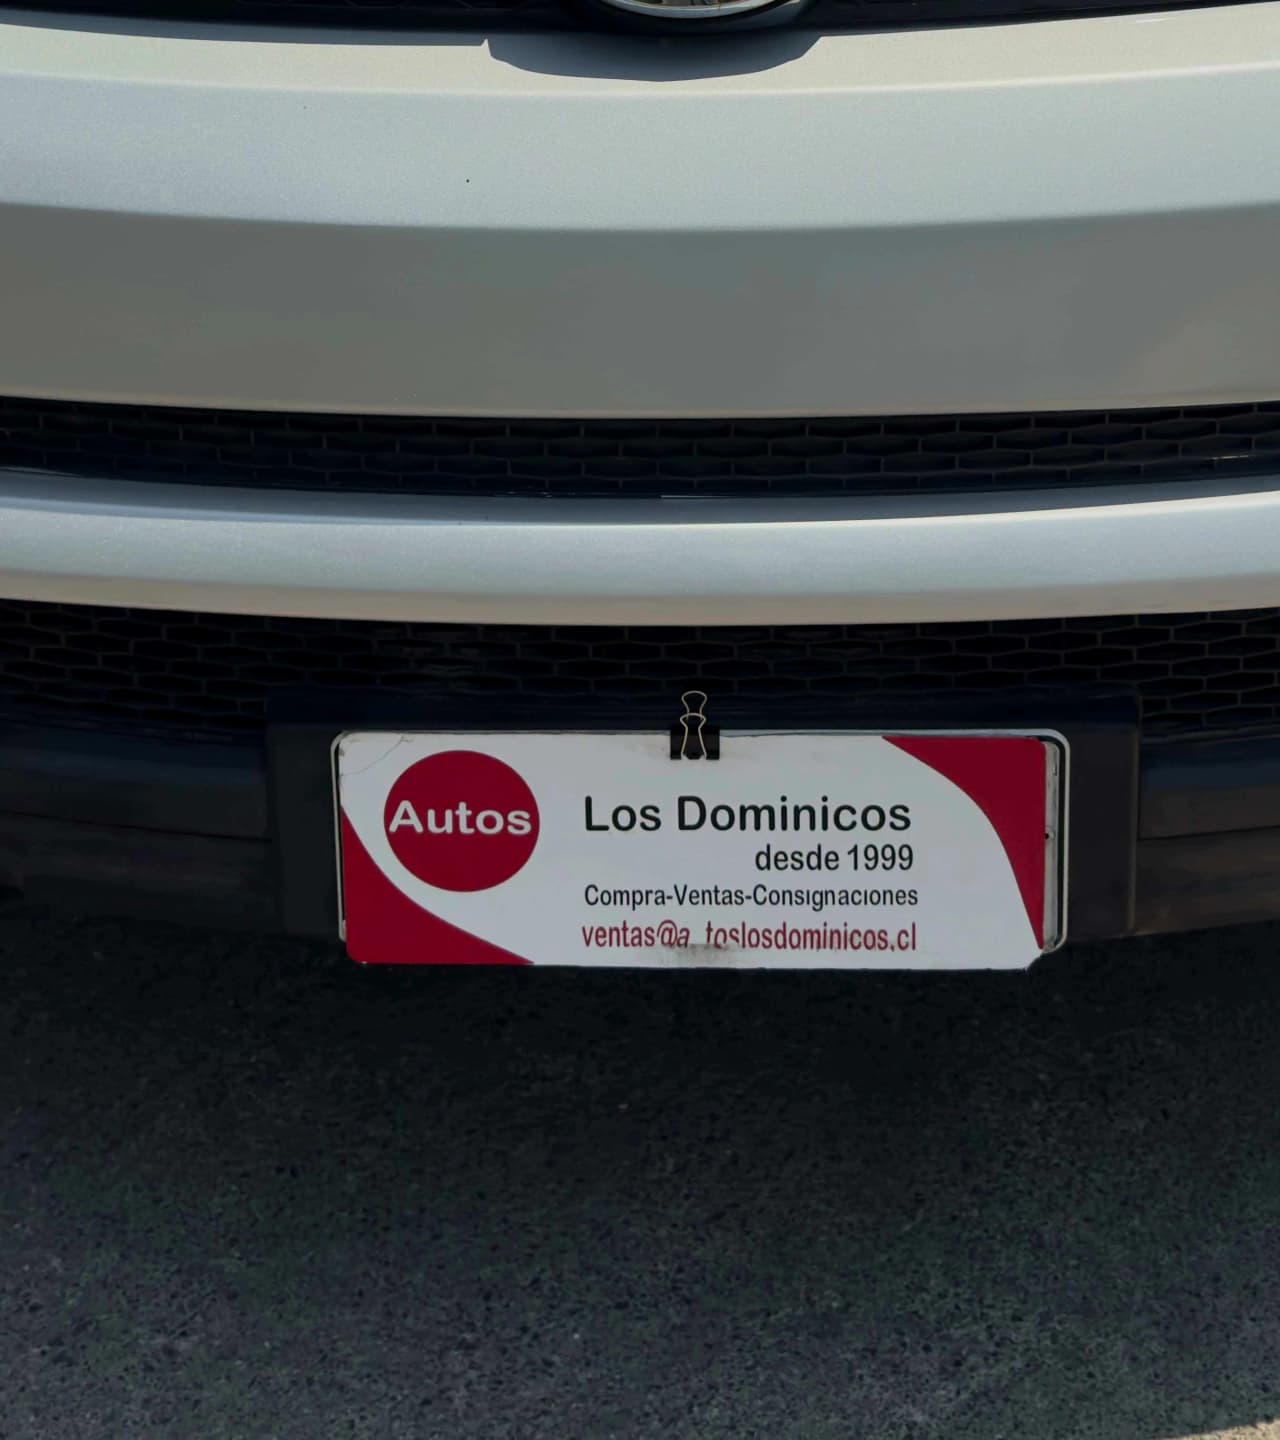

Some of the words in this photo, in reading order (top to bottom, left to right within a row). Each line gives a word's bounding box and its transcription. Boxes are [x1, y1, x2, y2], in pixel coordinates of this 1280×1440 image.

[389, 800, 532, 835] Autos
[584, 795, 662, 832] Los
[677, 795, 911, 832] Dominicos
[755, 843, 840, 871] desde
[847, 843, 914, 871] 1999
[584, 883, 918, 912] Compra-Ventas-Consignaciones
[582, 919, 916, 952] ventas@atoslosdominicos.cl
